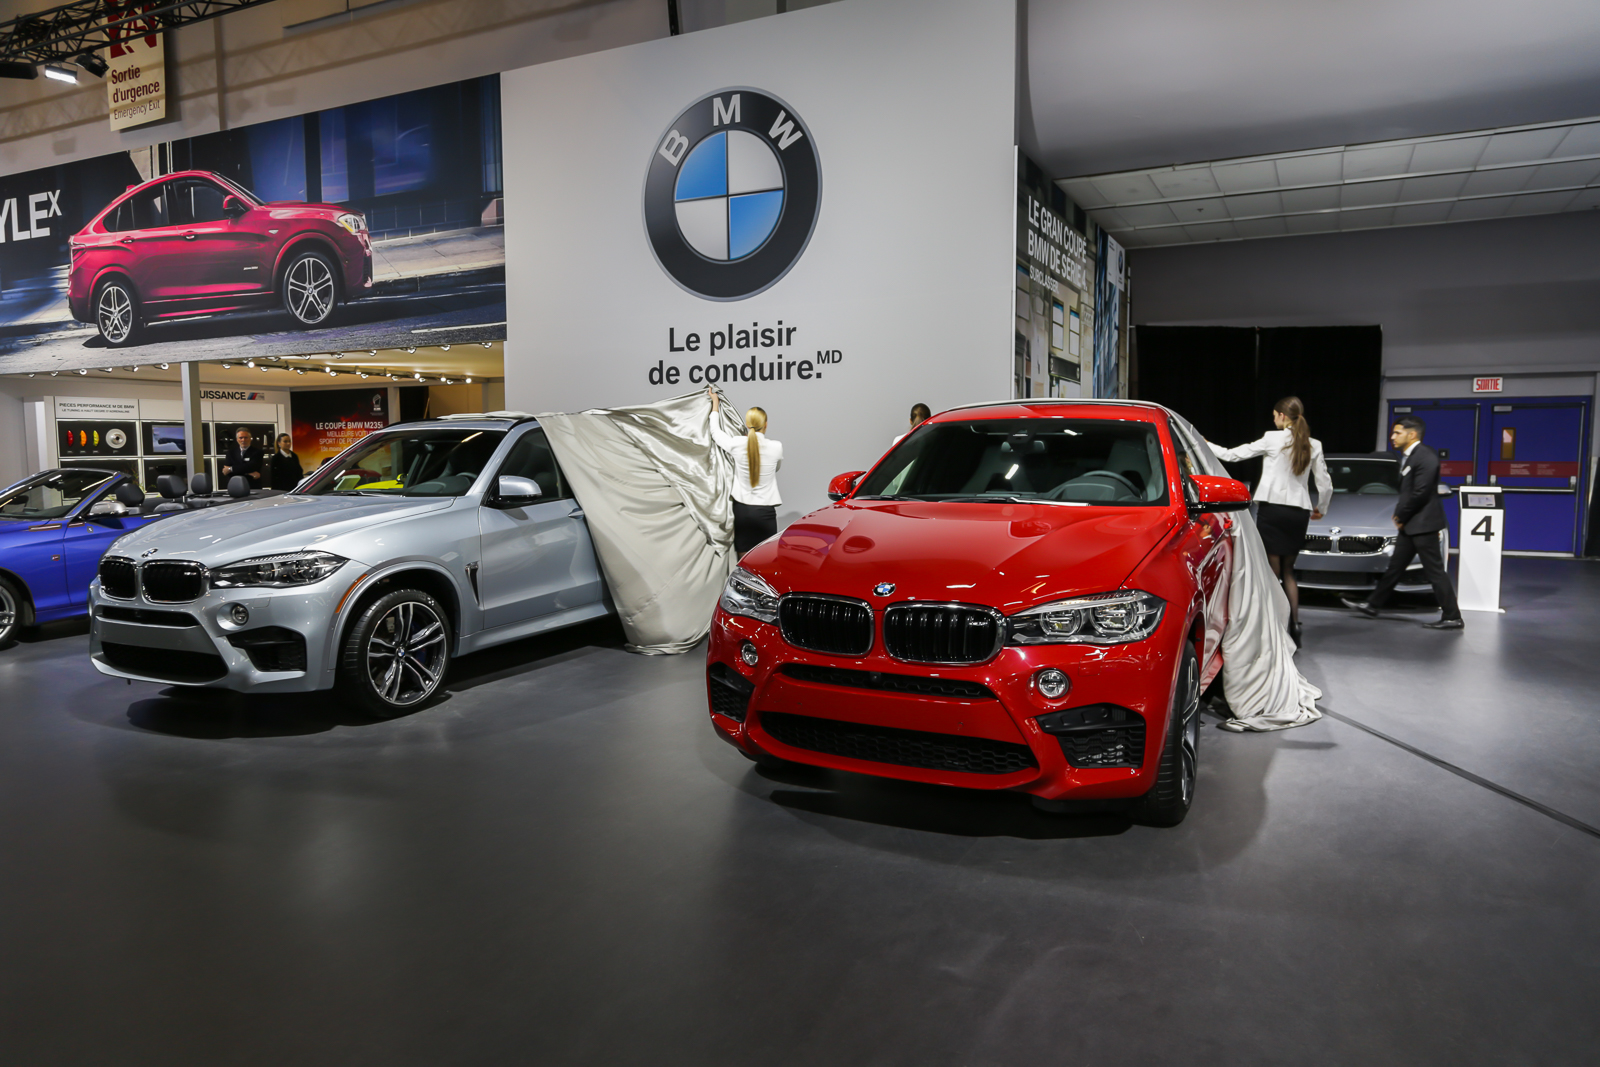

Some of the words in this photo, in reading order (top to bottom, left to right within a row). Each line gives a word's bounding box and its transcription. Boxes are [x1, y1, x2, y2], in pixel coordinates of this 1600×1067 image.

[111, 65, 140, 84] Sortie
[113, 81, 160, 103] d'urgence
[114, 104, 147, 120] Emergency
[148, 99, 160, 111] Exit
[658, 93, 803, 166] BMW
[1028, 195, 1040, 228] LE
[1040, 206, 1063, 246] GRAN
[1063, 226, 1087, 264] COUPÉ
[1028, 229, 1050, 267] BMW
[1049, 245, 1061, 275] DE
[1061, 252, 1082, 288] SÉRIE
[669, 327, 701, 352] Le
[710, 320, 797, 356] plaisir
[648, 360, 680, 385] de
[1476, 378, 1500, 390] SORTIE
[200, 390, 246, 400] UISSANCE
[315, 422, 324, 430] LE
[347, 421, 363, 429] BMW
[1471, 515, 1495, 541] 4
